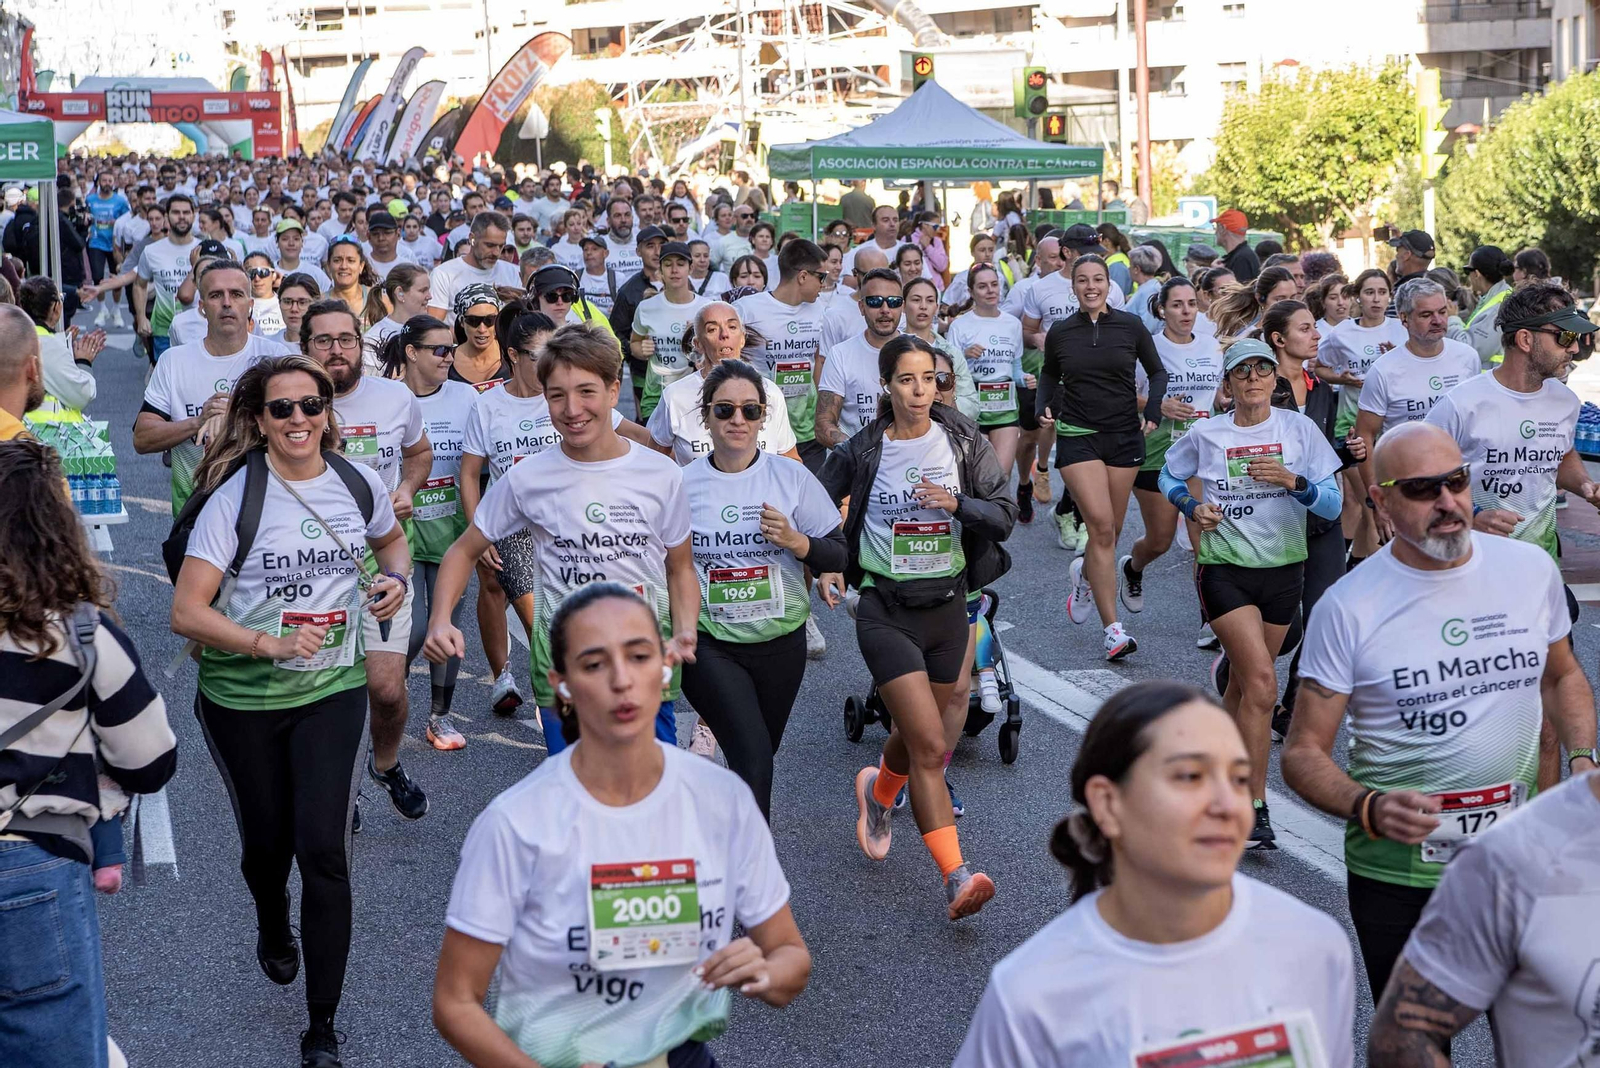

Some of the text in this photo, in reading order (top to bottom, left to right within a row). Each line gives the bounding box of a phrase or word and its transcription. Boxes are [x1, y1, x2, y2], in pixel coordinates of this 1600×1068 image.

[486, 50, 538, 113] FROIZ
[107, 91, 150, 107] RUN
[107, 108, 150, 122] RUN
[818, 155, 897, 169] ASOCIACIÓN
[901, 156, 968, 169] ESPAÑOLA
[974, 158, 1024, 169] CONTRA
[1027, 159, 1042, 169] EL
[163, 284, 180, 294] Vig
[1050, 306, 1062, 315] En
[258, 316, 280, 324] rcha
[766, 340, 781, 350] En
[974, 365, 995, 376] Vigo
[784, 375, 804, 383] 5074
[1168, 372, 1183, 382] En
[857, 393, 872, 404] En
[1407, 400, 1425, 412] En
[348, 442, 364, 452] 93
[433, 440, 462, 450] rcha
[496, 432, 562, 453] En March
[691, 440, 710, 452] En
[1486, 449, 1508, 463] En
[1481, 477, 1523, 498] Vigo
[421, 492, 446, 504] 1696
[879, 492, 898, 505] En
[882, 507, 908, 515] contra
[1219, 503, 1254, 520] Vigo
[554, 536, 577, 548] En
[692, 530, 768, 547] En Marc
[908, 540, 939, 552] 1401
[558, 554, 590, 563] contra
[593, 553, 604, 563] el
[694, 551, 721, 560] contra
[724, 551, 734, 559] el
[736, 549, 772, 558] cáncer
[262, 553, 290, 569] En
[265, 565, 356, 583] contra el cáncer
[722, 586, 756, 600] 1969
[1471, 613, 1508, 623] asociación
[1473, 622, 1505, 632] española
[1474, 632, 1498, 640] contra
[1392, 648, 1540, 690] En Marcha
[1397, 676, 1537, 707] contra el cáncer en
[1400, 710, 1467, 736] Vigo
[612, 894, 681, 923] 2000
[573, 974, 644, 1005] Vigo
